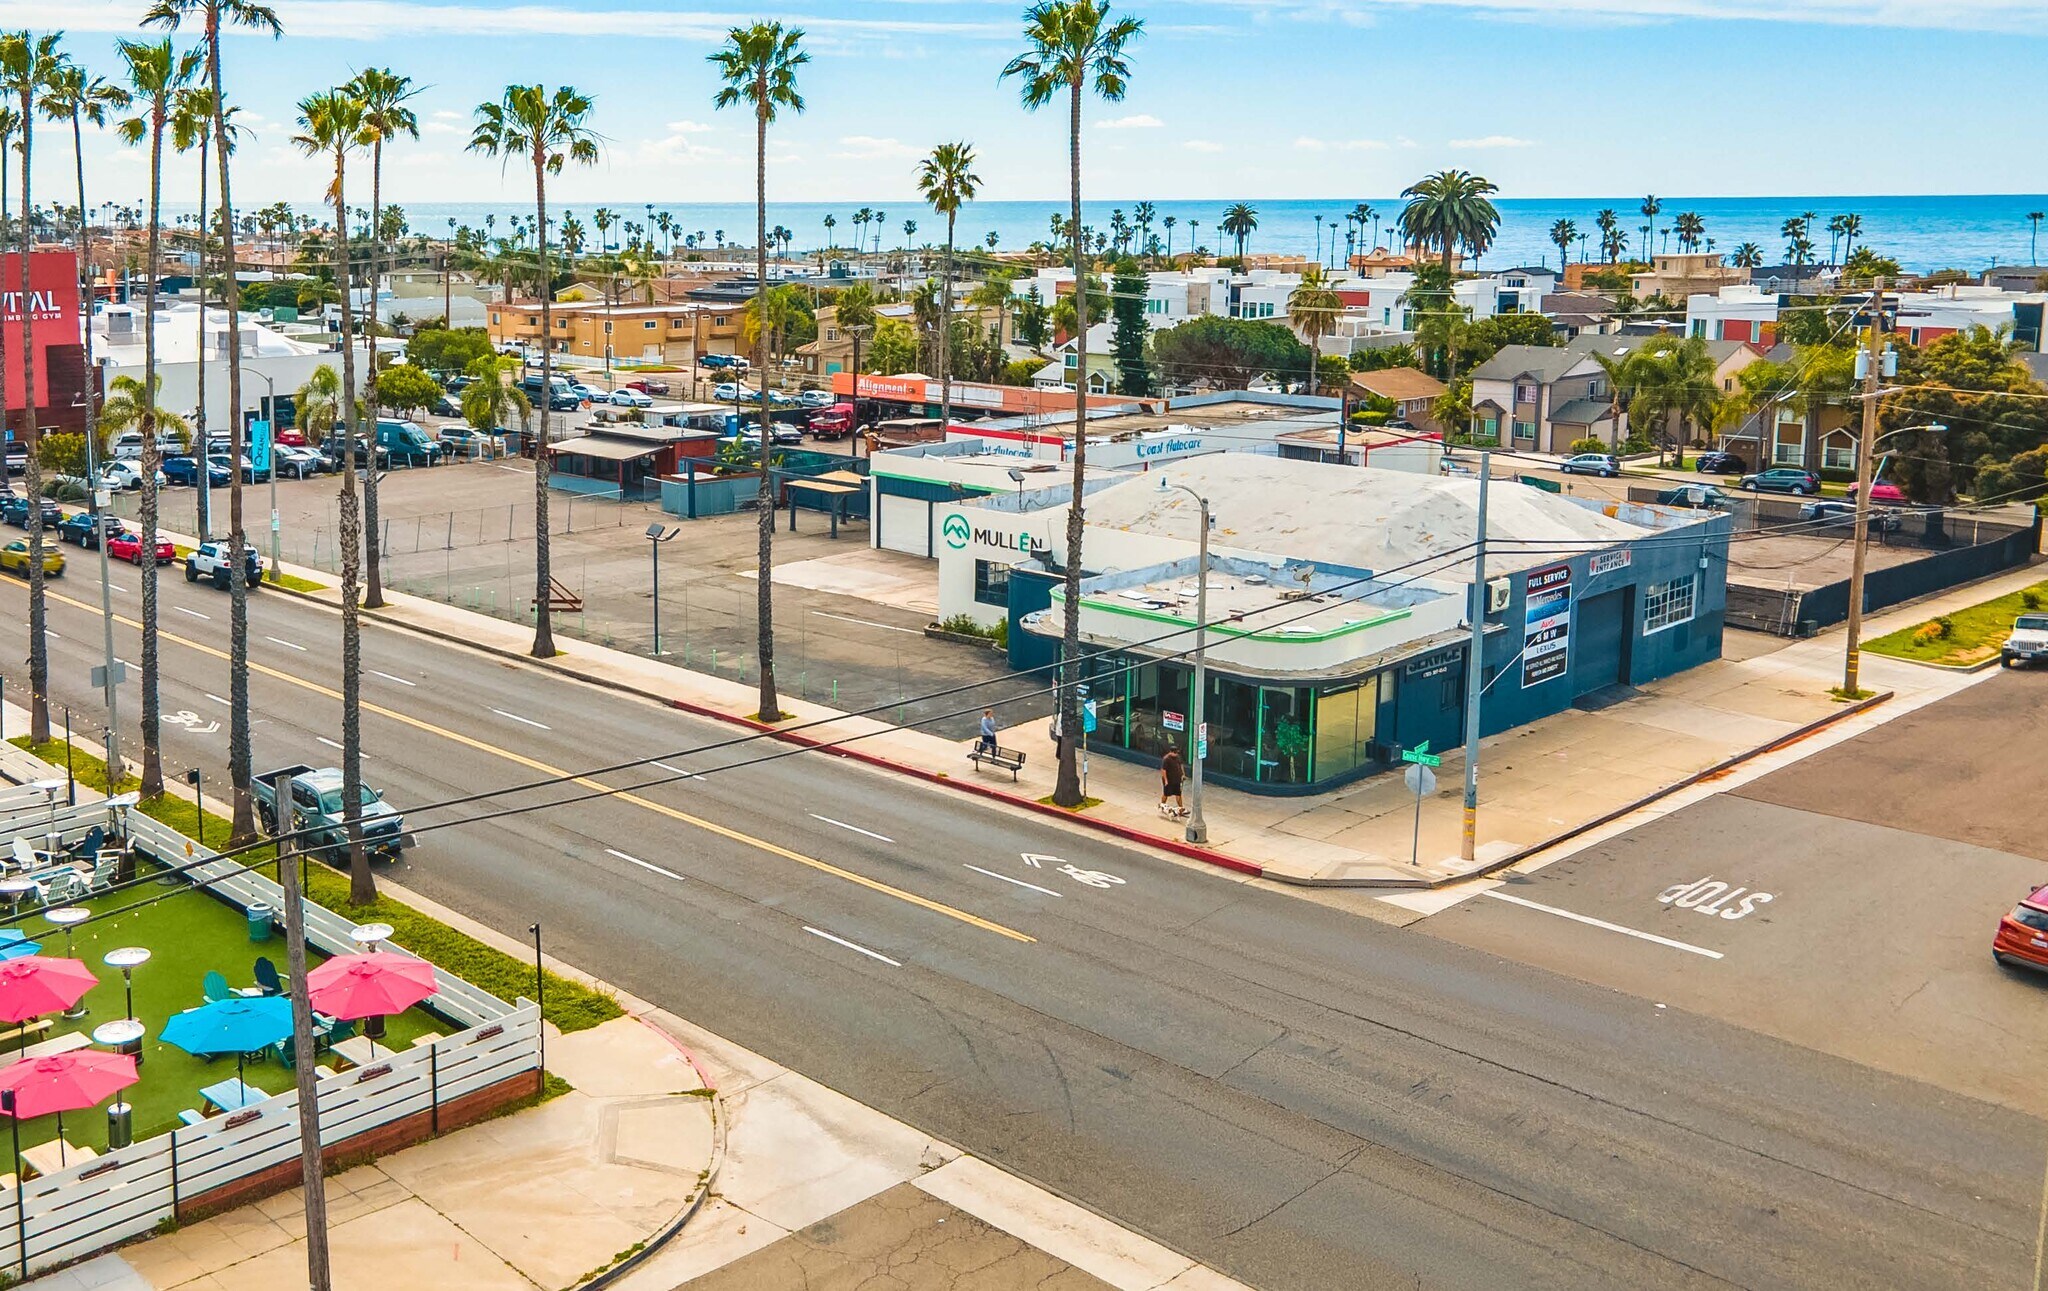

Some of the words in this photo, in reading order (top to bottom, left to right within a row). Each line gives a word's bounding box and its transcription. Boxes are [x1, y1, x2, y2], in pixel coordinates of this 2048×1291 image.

[857, 378, 907, 395] Alignment
[1166, 439, 1202, 454] Autocare
[1528, 577, 1542, 589] FULL
[1543, 569, 1567, 584] SERVICE
[1536, 590, 1563, 605] Mercedes
[1536, 641, 1556, 654] LEXUS
[1656, 875, 1774, 920] STOP
